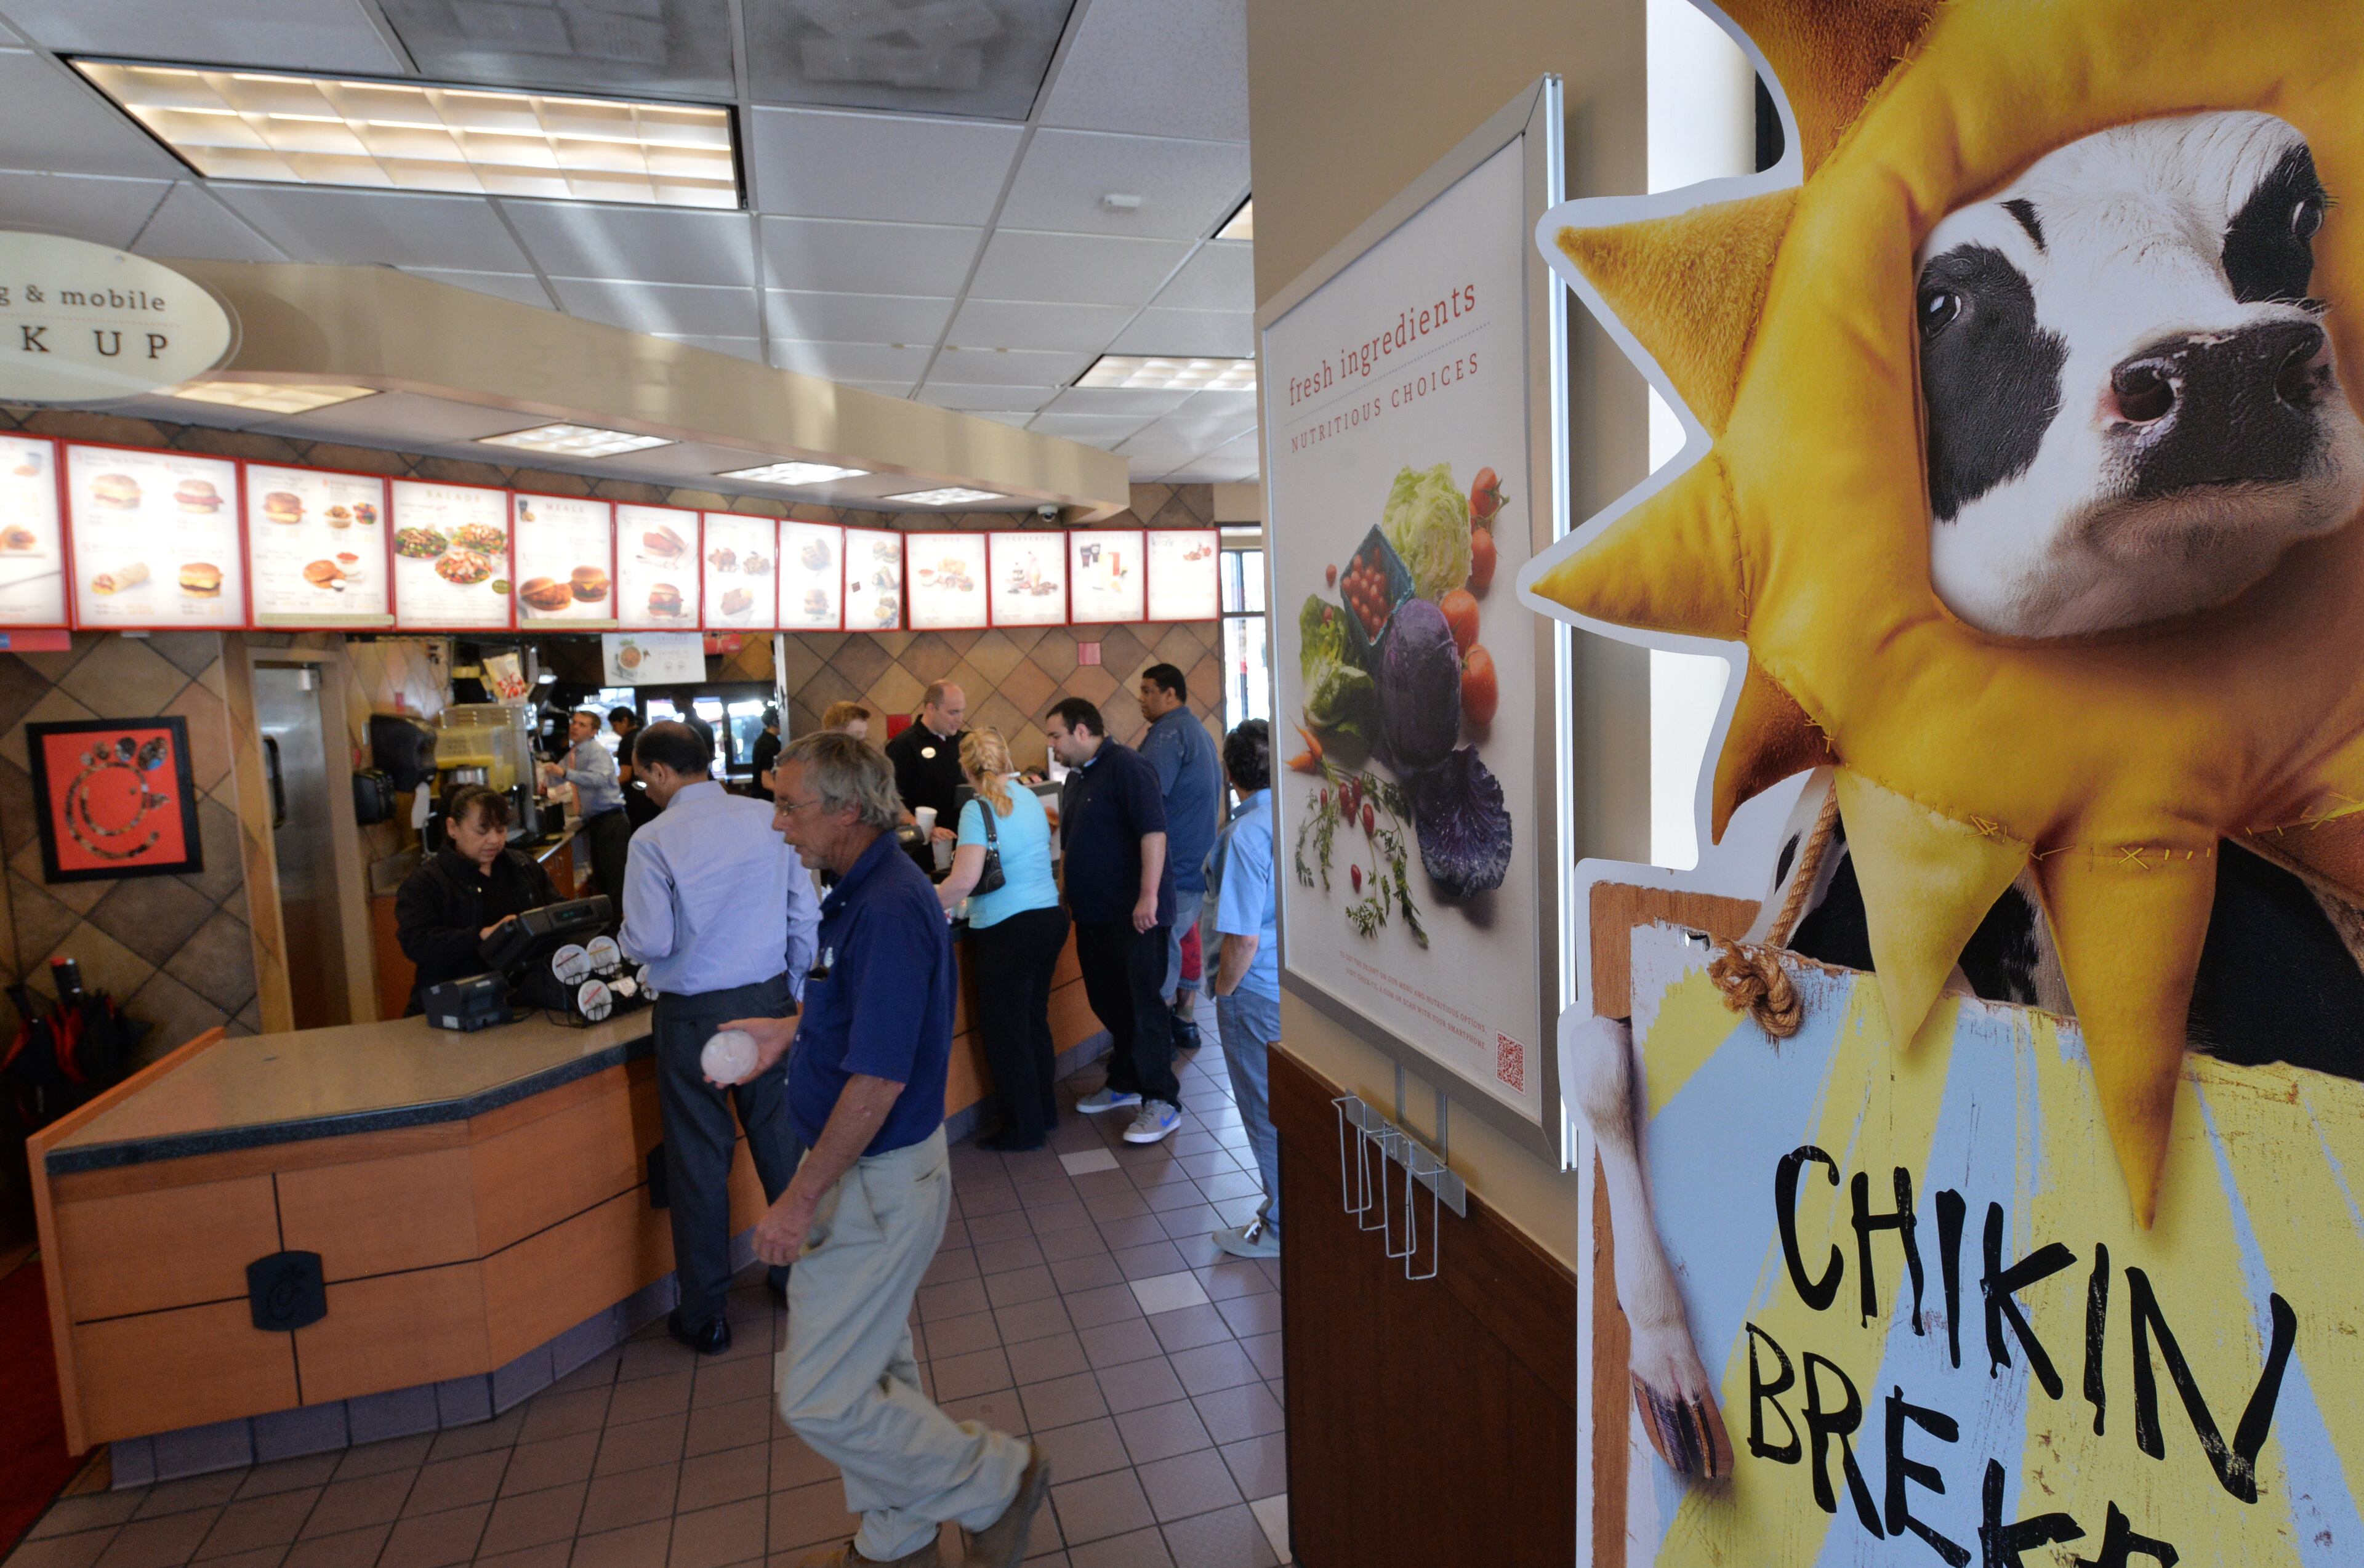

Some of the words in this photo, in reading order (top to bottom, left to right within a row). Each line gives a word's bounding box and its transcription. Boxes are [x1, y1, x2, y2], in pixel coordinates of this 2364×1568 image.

[25, 284, 46, 304] &
[60, 288, 166, 311] mobile
[20, 324, 50, 353] K
[93, 329, 168, 360] UP
[1289, 359, 1333, 406] fresh
[1340, 284, 1476, 379] ingredients
[1291, 398, 1381, 453] NUTRITIOUS
[1391, 353, 1478, 408] CHOICES
[1380, 971, 1387, 981] ON
[1388, 975, 1397, 986] OUR
[1413, 989, 1425, 1000] AND
[1426, 995, 1458, 1018] NUTRITIOUS
[1395, 994, 1402, 1003] OR
[1403, 998, 1416, 1010] SCAN
[1417, 1005, 1431, 1019] WITH
[1432, 1013, 1446, 1027] YOUR
[1775, 1144, 2298, 1504] CHIKIN
